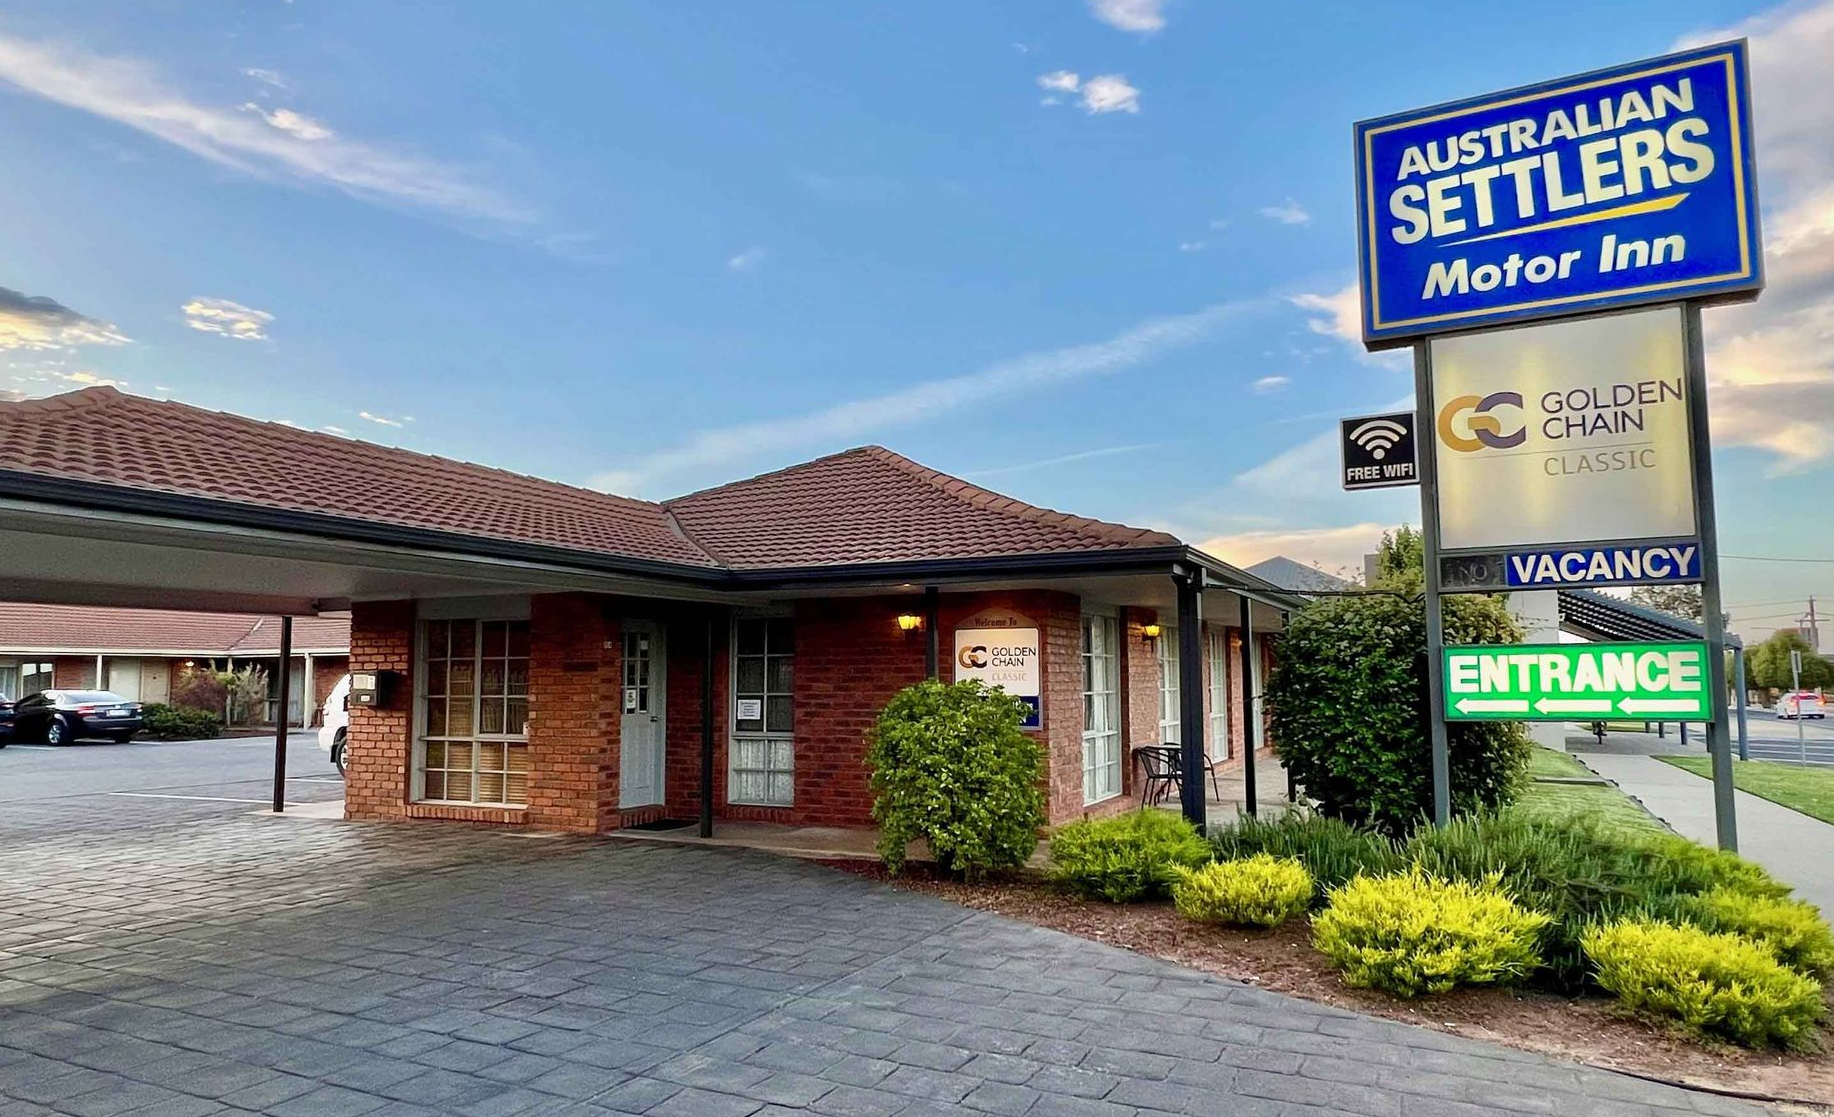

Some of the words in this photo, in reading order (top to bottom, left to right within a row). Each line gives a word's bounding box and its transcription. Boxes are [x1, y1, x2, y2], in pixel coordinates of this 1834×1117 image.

[1396, 77, 1695, 181] AUSTRALIAN
[1389, 117, 1715, 245] SETTLERS
[1421, 250, 1581, 300] Motor
[1598, 234, 1686, 274] Inn
[1540, 378, 1684, 415] GOLDEN
[1542, 408, 1645, 440] CHAIN
[1346, 466, 1381, 481] FREE
[1544, 448, 1657, 477] CLASSIC
[1511, 545, 1697, 585] VACANCY
[1008, 617, 1017, 626] To
[991, 647, 1036, 656] GOLDEN
[991, 658, 1024, 667] CHAIN
[992, 673, 1027, 681] CLASSIC
[1449, 651, 1702, 693] ENTRANCE
